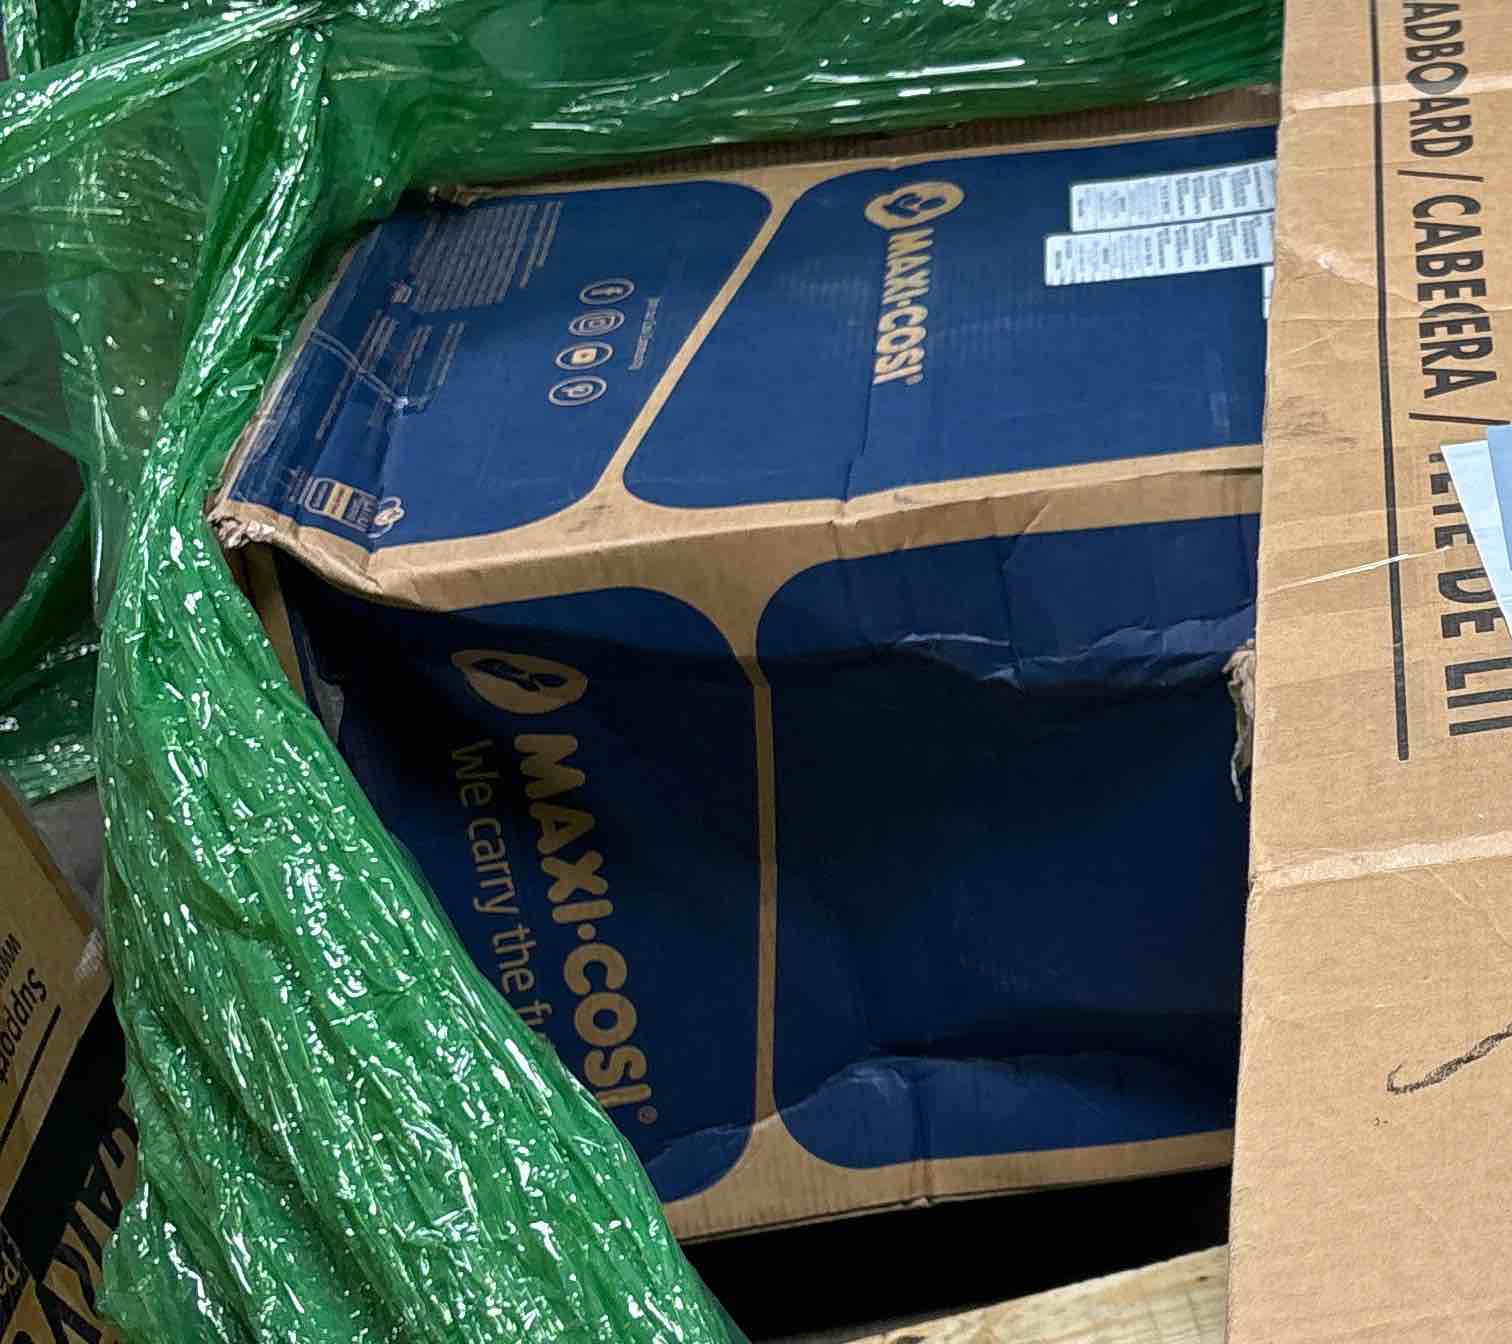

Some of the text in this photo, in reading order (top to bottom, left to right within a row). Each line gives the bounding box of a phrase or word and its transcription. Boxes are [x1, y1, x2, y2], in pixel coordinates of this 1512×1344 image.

[1412, 194, 1497, 399] CABECERA
[452, 739, 537, 994] We carry the
